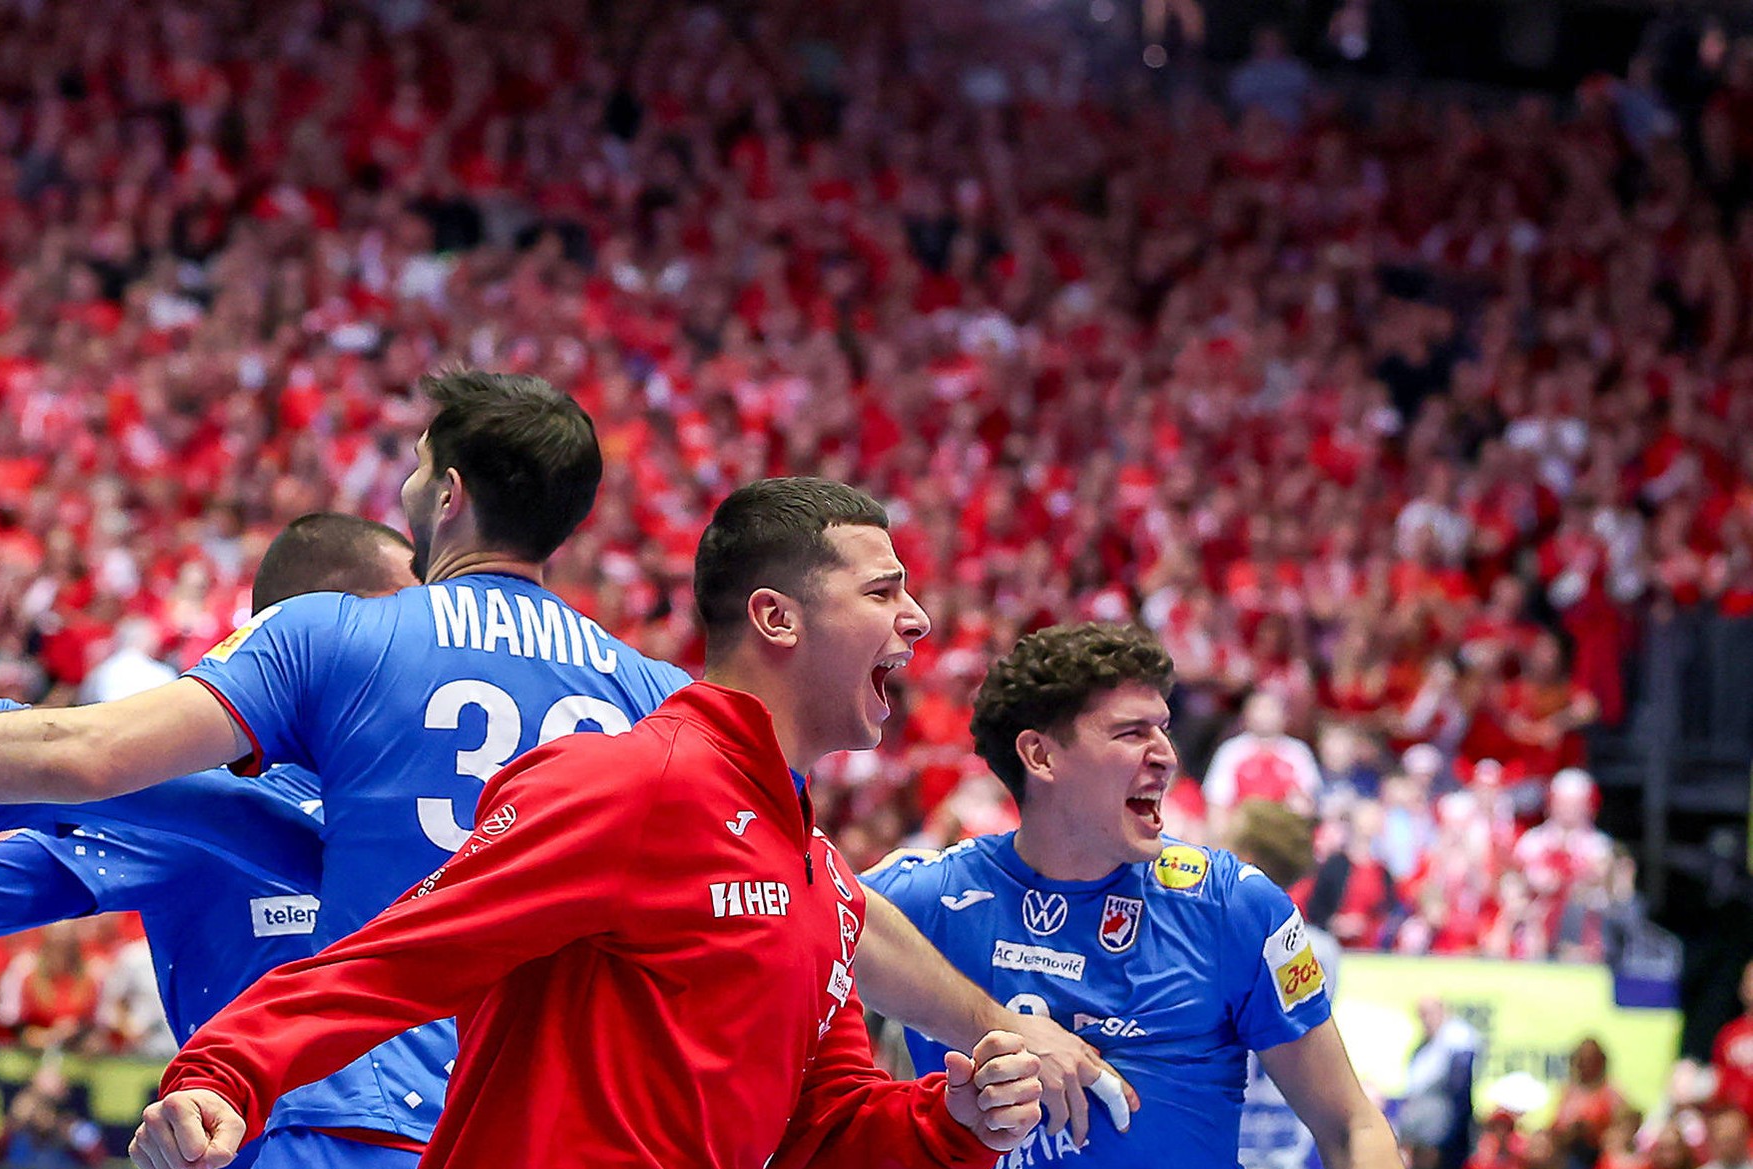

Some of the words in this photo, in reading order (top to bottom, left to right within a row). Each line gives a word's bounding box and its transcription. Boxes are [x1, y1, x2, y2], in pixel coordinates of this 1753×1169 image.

[427, 583, 618, 674] MAMIC
[744, 881, 791, 916] HEP
[995, 947, 1013, 962] AC
